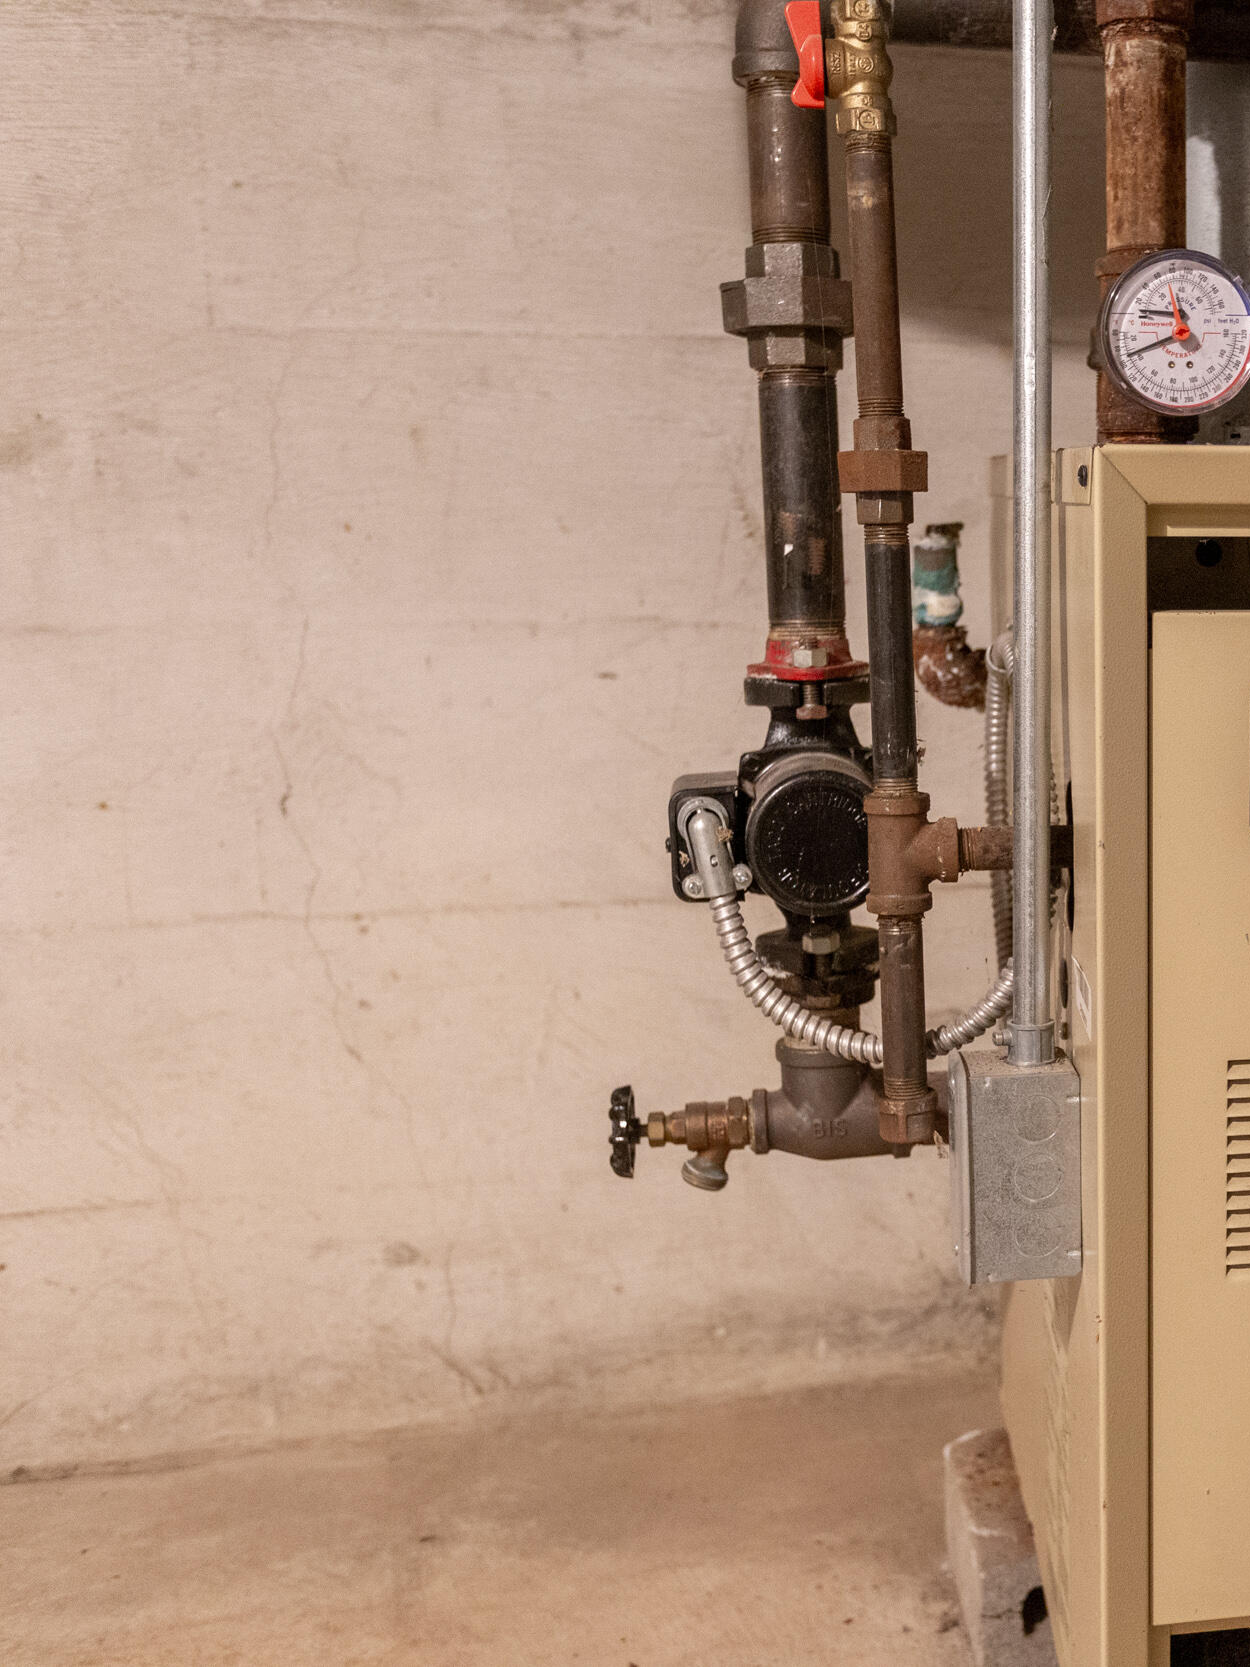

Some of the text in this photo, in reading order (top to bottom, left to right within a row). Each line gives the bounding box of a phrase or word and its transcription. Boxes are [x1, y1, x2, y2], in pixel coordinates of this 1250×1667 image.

[1198, 273, 1208, 282] 120
[1210, 284, 1219, 294] 140
[1206, 365, 1216, 374] 120
[1128, 372, 1138, 382] 120
[1141, 383, 1150, 393] 140
[1199, 391, 1209, 400] 220
